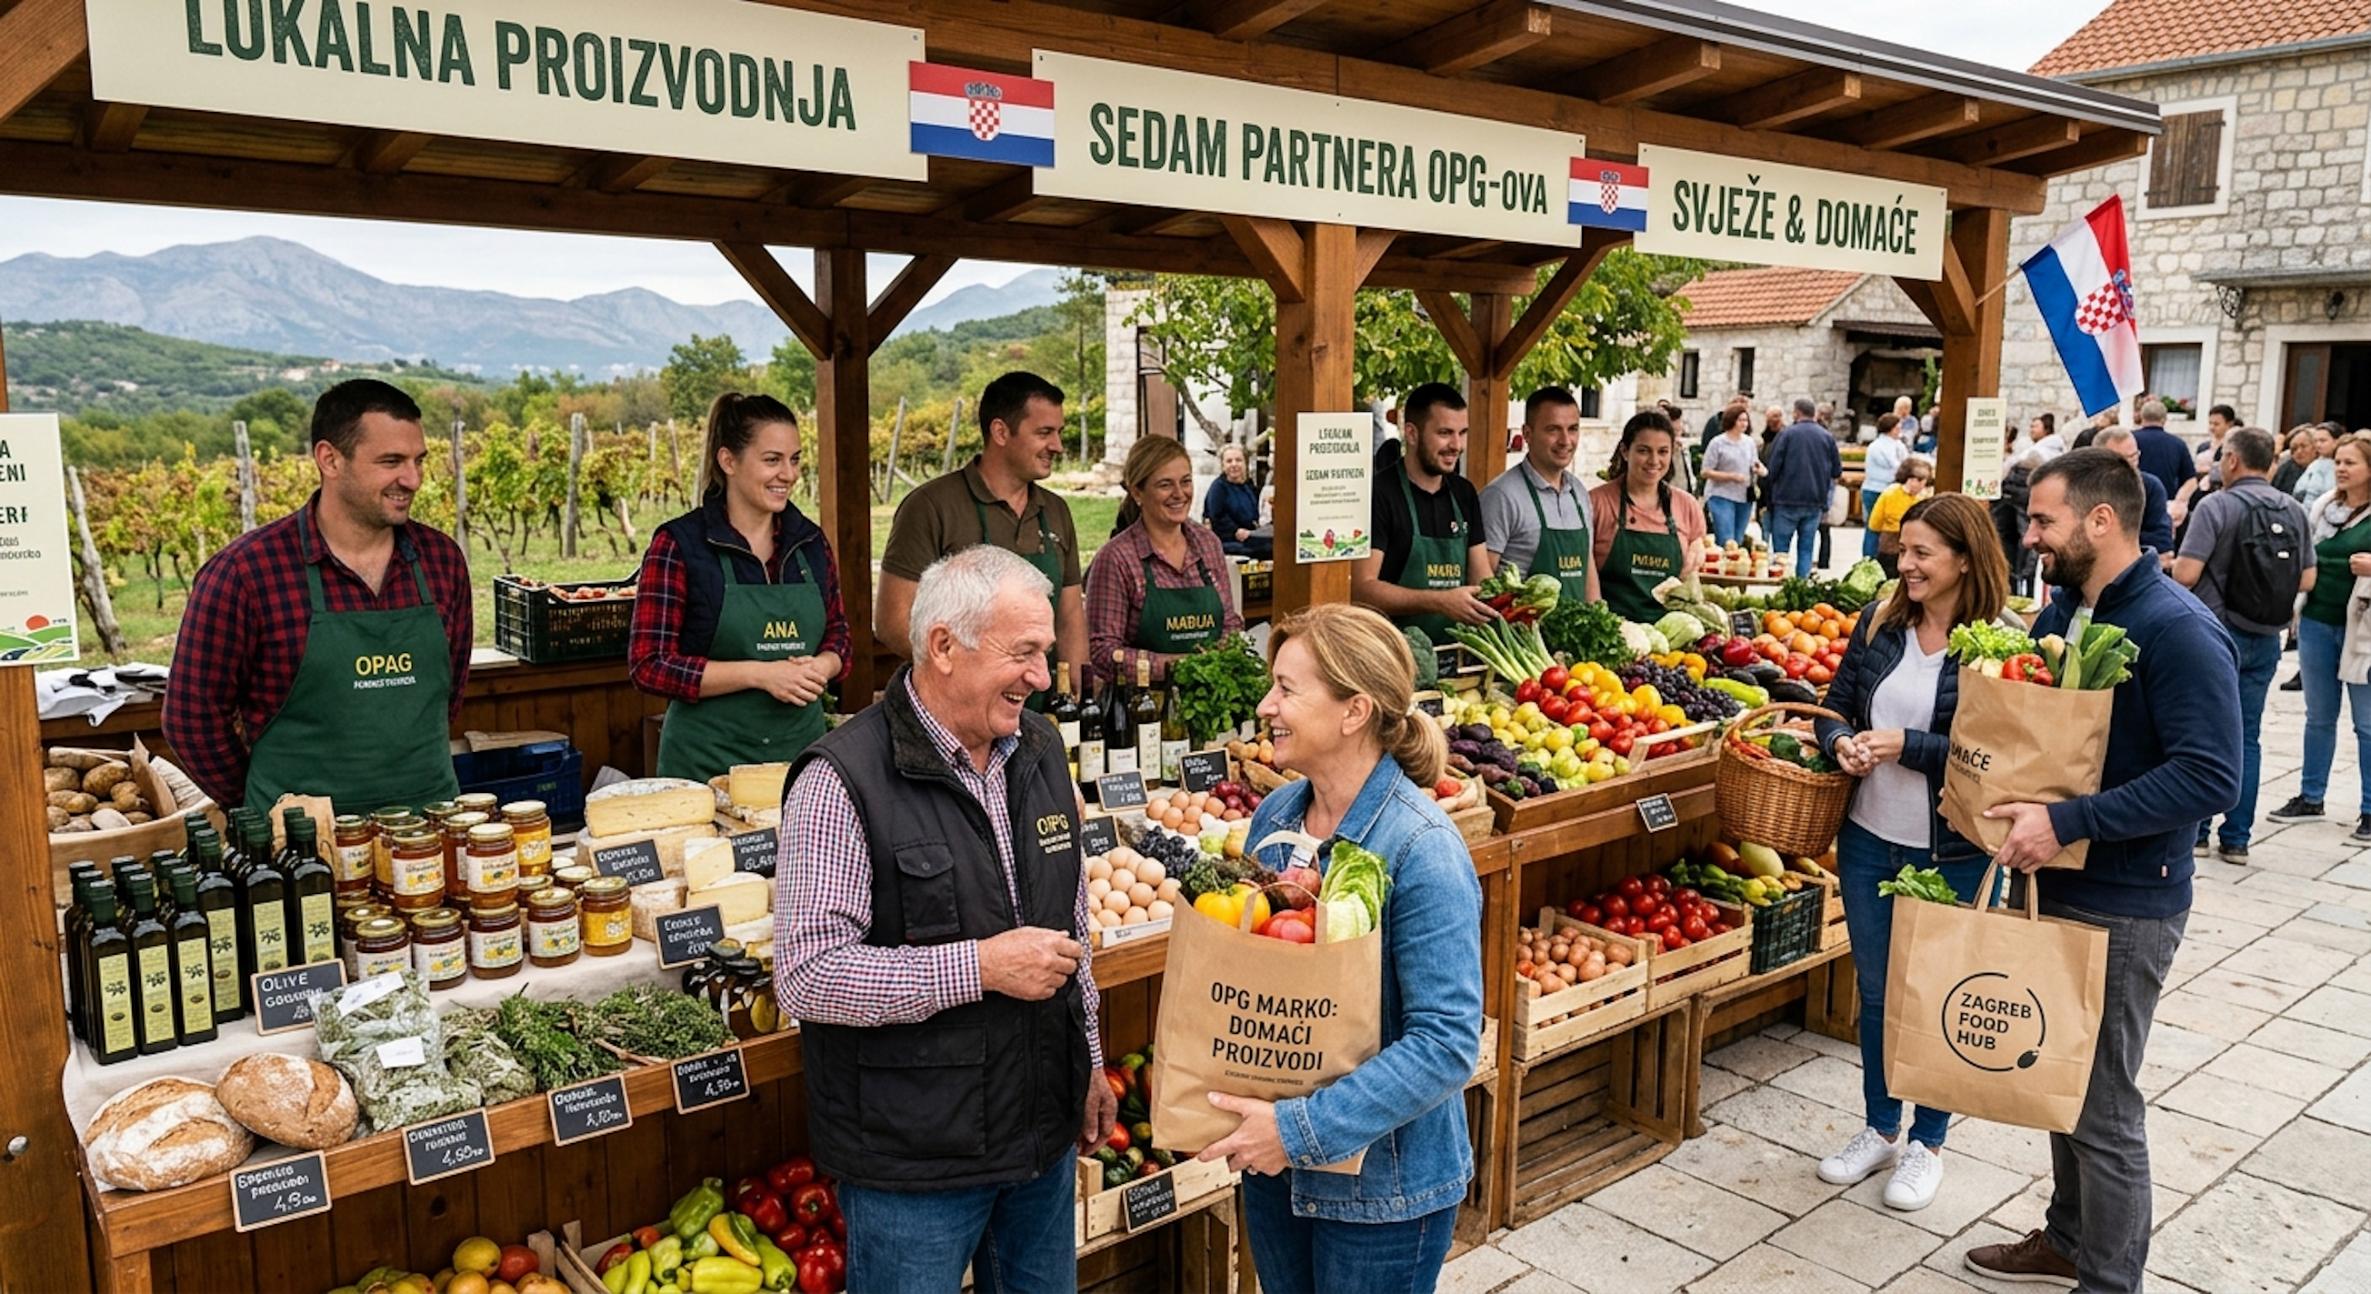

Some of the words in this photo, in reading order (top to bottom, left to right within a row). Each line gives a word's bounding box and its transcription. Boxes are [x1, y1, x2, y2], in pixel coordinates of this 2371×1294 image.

[495, 20, 857, 131] PROIZVODNJA
[1090, 102, 1227, 178] SEDAM
[1242, 122, 1418, 200] PARTNERA
[1672, 173, 1777, 240] SVJEŽE
[1785, 194, 1806, 244] &
[1815, 194, 1919, 255] DOMAĆE
[763, 621, 800, 640] ANA
[355, 652, 413, 677] OPAG
[1211, 982, 1251, 1010] OPG
[1256, 993, 1339, 1019] MARKO:
[1960, 992, 2032, 1020] ZAGREB
[1212, 1037, 1324, 1071] PROIZVODI
[1956, 1029, 1997, 1050] HUB
